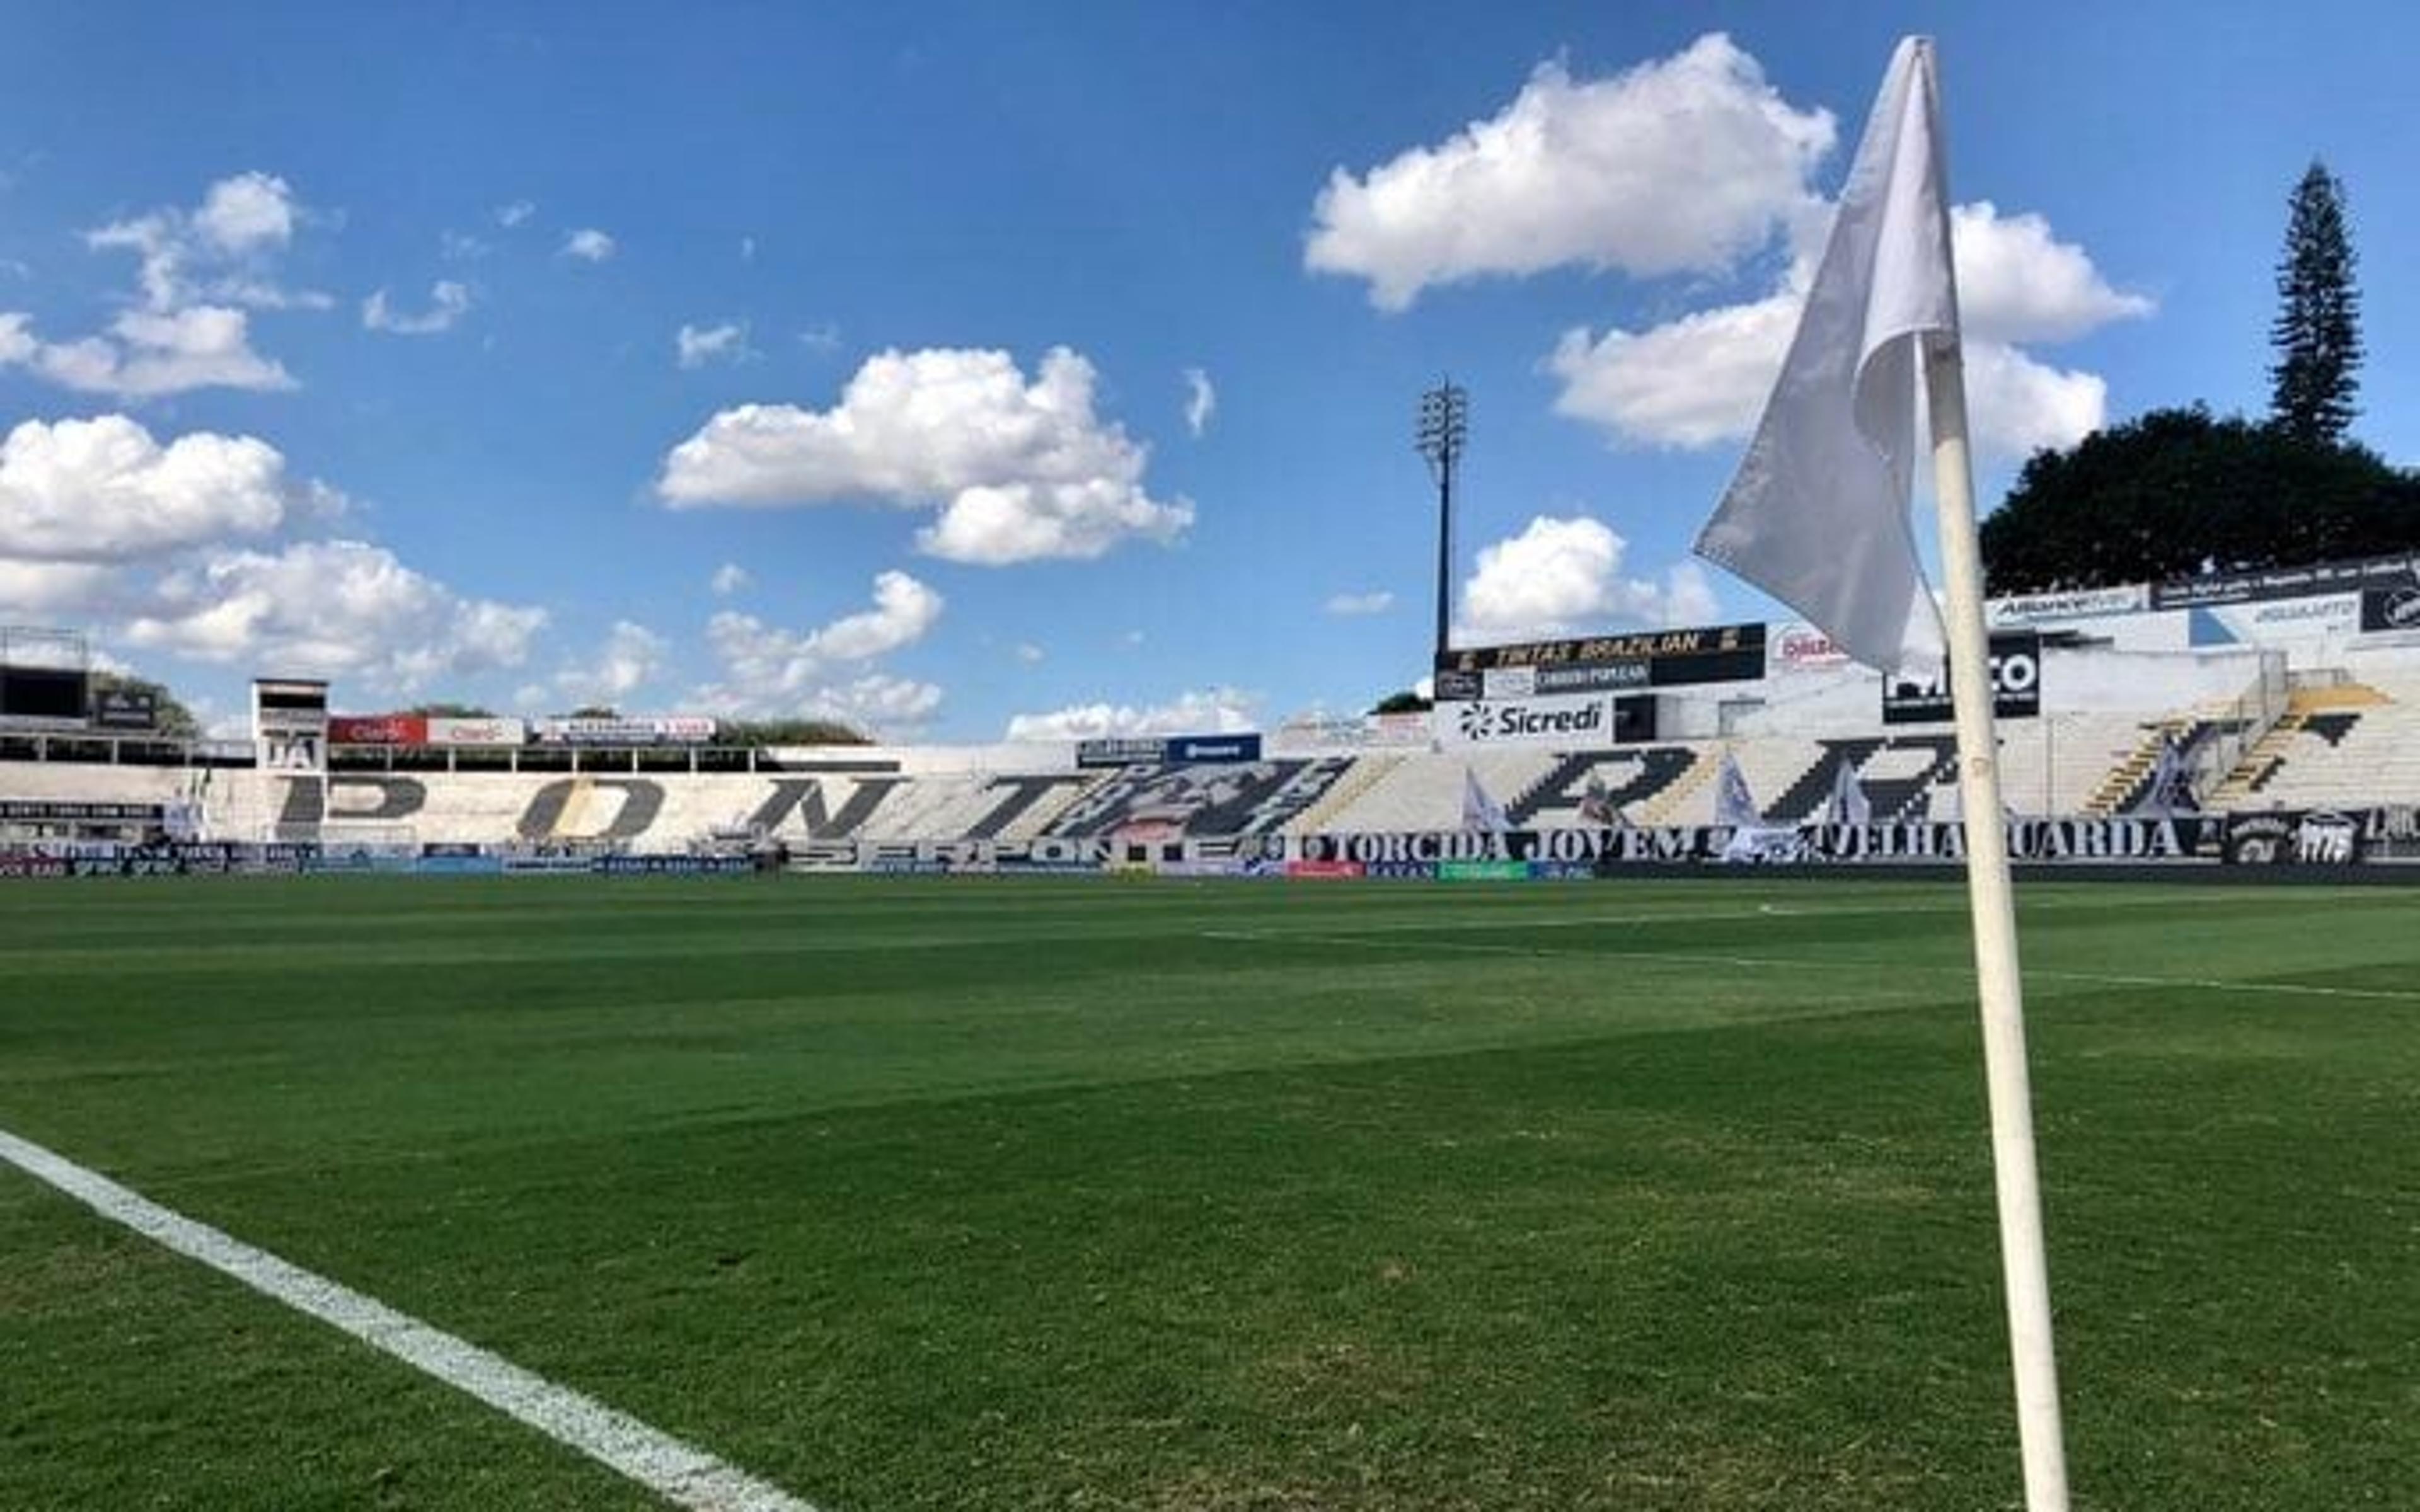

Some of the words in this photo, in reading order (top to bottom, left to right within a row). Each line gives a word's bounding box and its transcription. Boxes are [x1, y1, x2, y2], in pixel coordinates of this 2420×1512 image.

[1499, 701, 1602, 736] Sicredi
[1331, 830, 1510, 862] TORCIDA
[1525, 827, 1694, 861] JOVEM
[2005, 820, 2183, 856] UARDA
